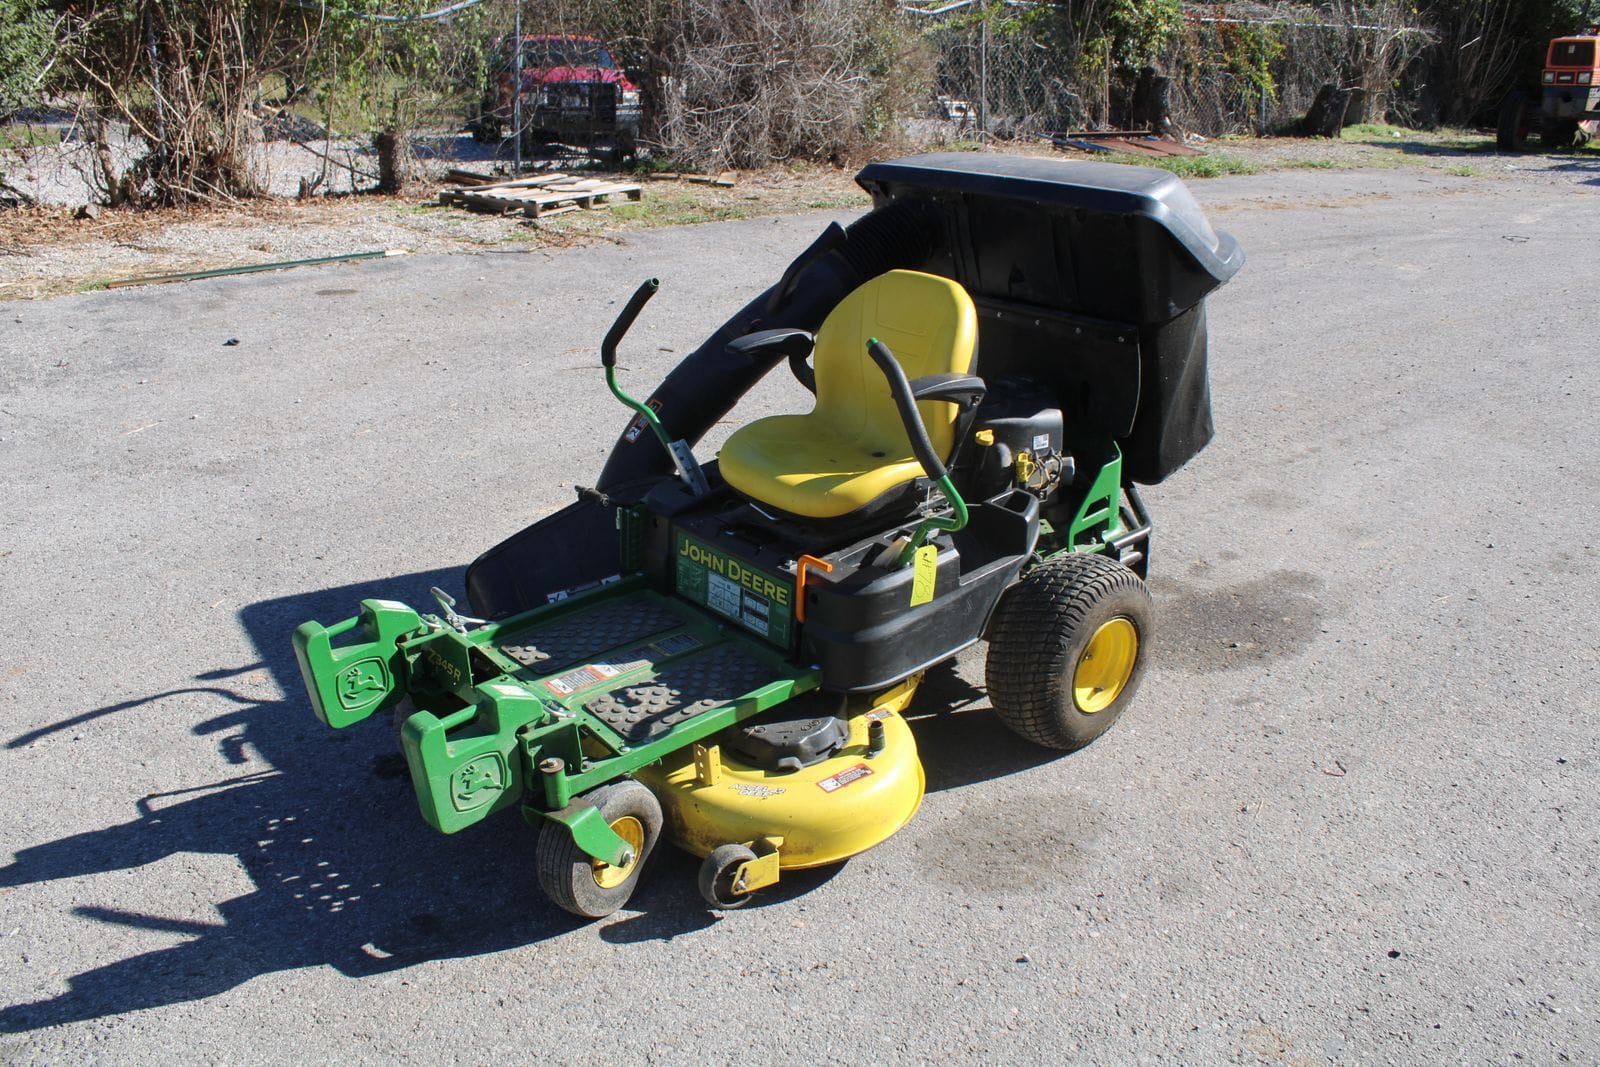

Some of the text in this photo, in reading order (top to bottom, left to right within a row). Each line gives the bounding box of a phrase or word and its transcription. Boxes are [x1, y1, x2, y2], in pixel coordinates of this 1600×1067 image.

[680, 539, 724, 574] JOHN
[728, 559, 788, 605] DEERE
[428, 648, 461, 682] Z345R
